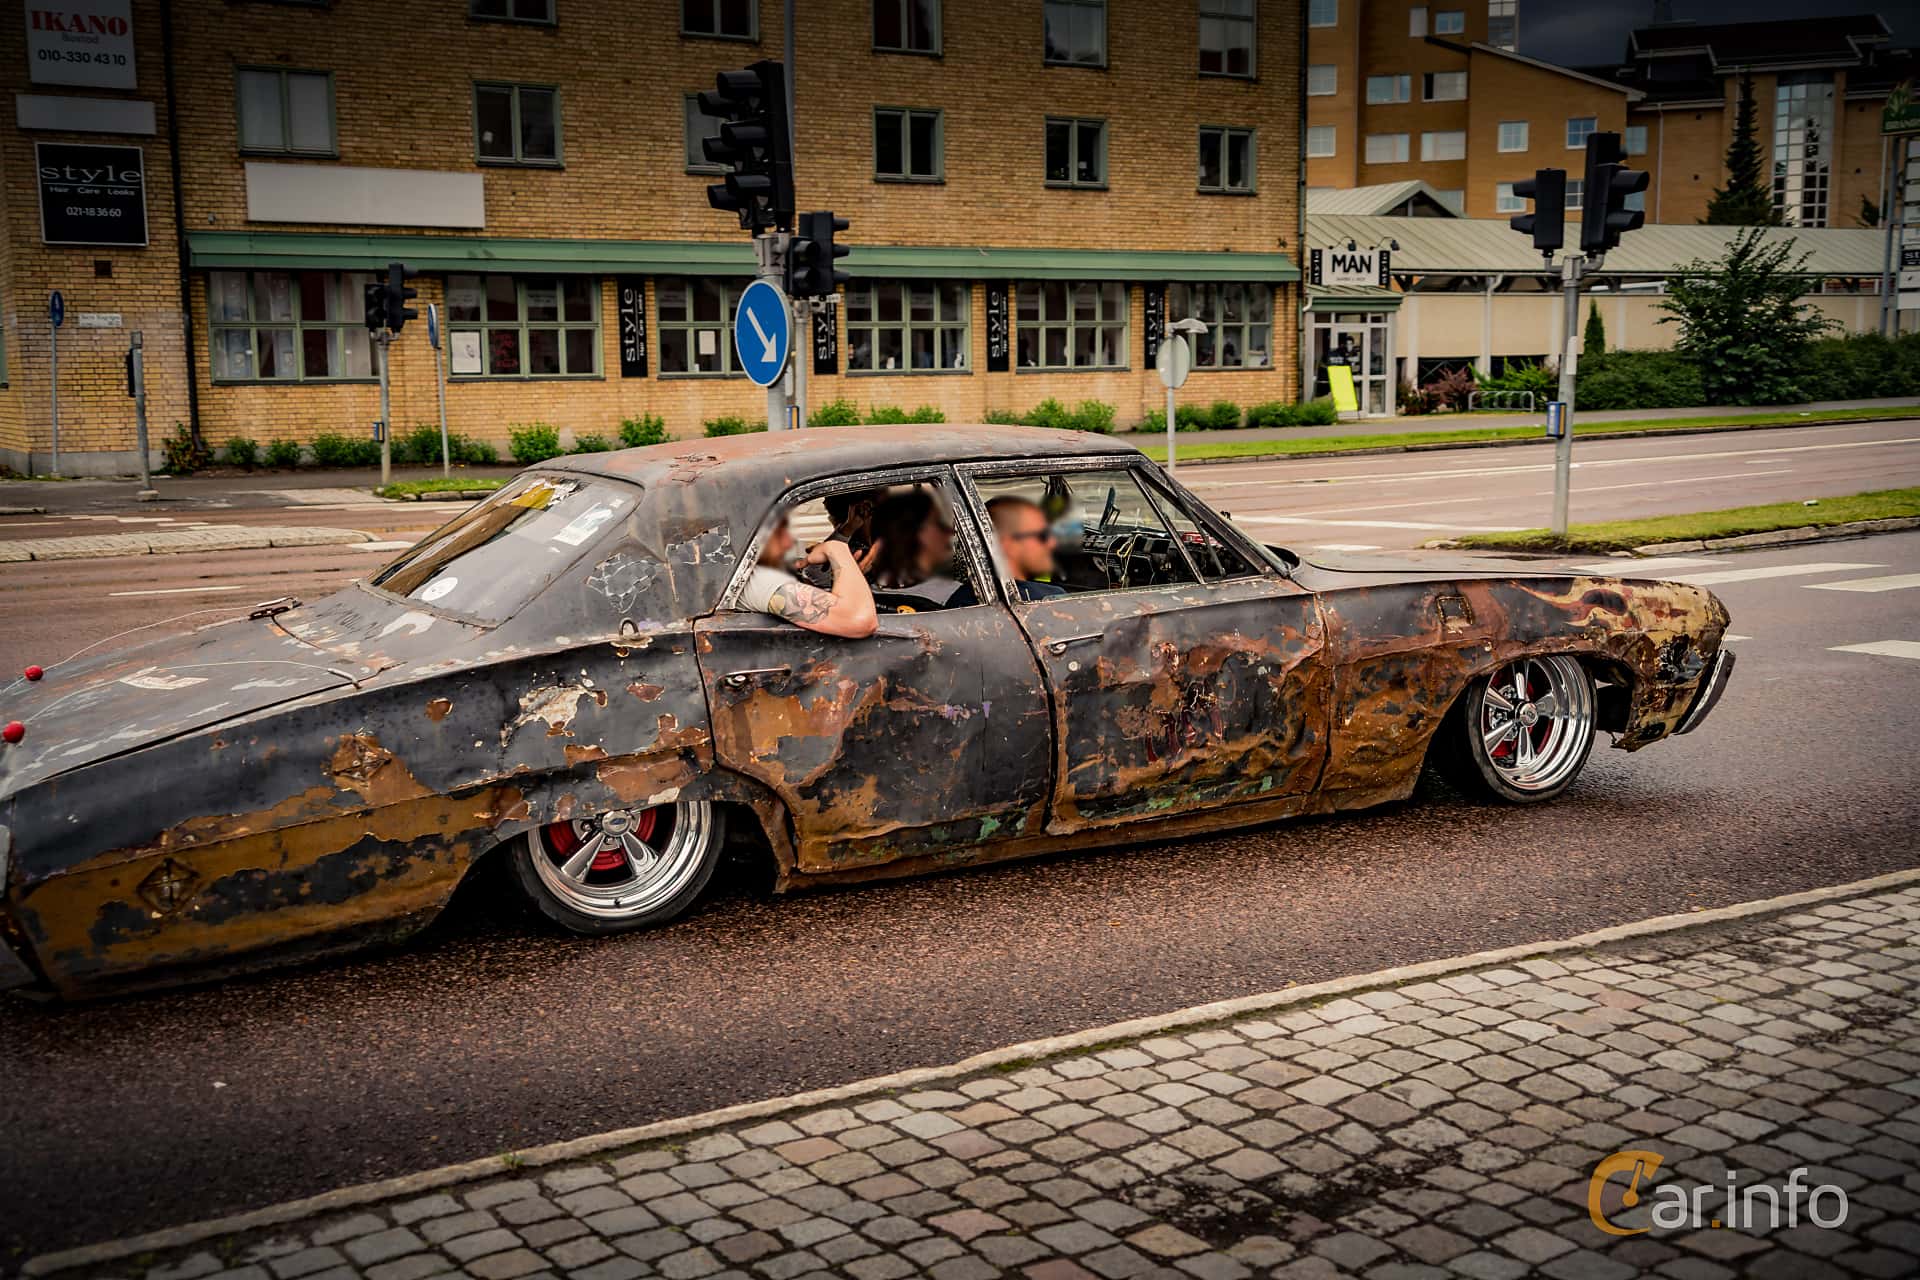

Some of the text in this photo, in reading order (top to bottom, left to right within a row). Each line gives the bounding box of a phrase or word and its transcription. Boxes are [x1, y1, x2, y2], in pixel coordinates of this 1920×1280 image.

[31, 10, 128, 36] IKANO
[38, 49, 126, 65] 010-330 43 10
[40, 164, 141, 183] style
[1331, 254, 1372, 273] MAN
[620, 288, 637, 362] style
[816, 316, 828, 360] sty
[988, 291, 1001, 358] style
[1146, 292, 1158, 356] style
